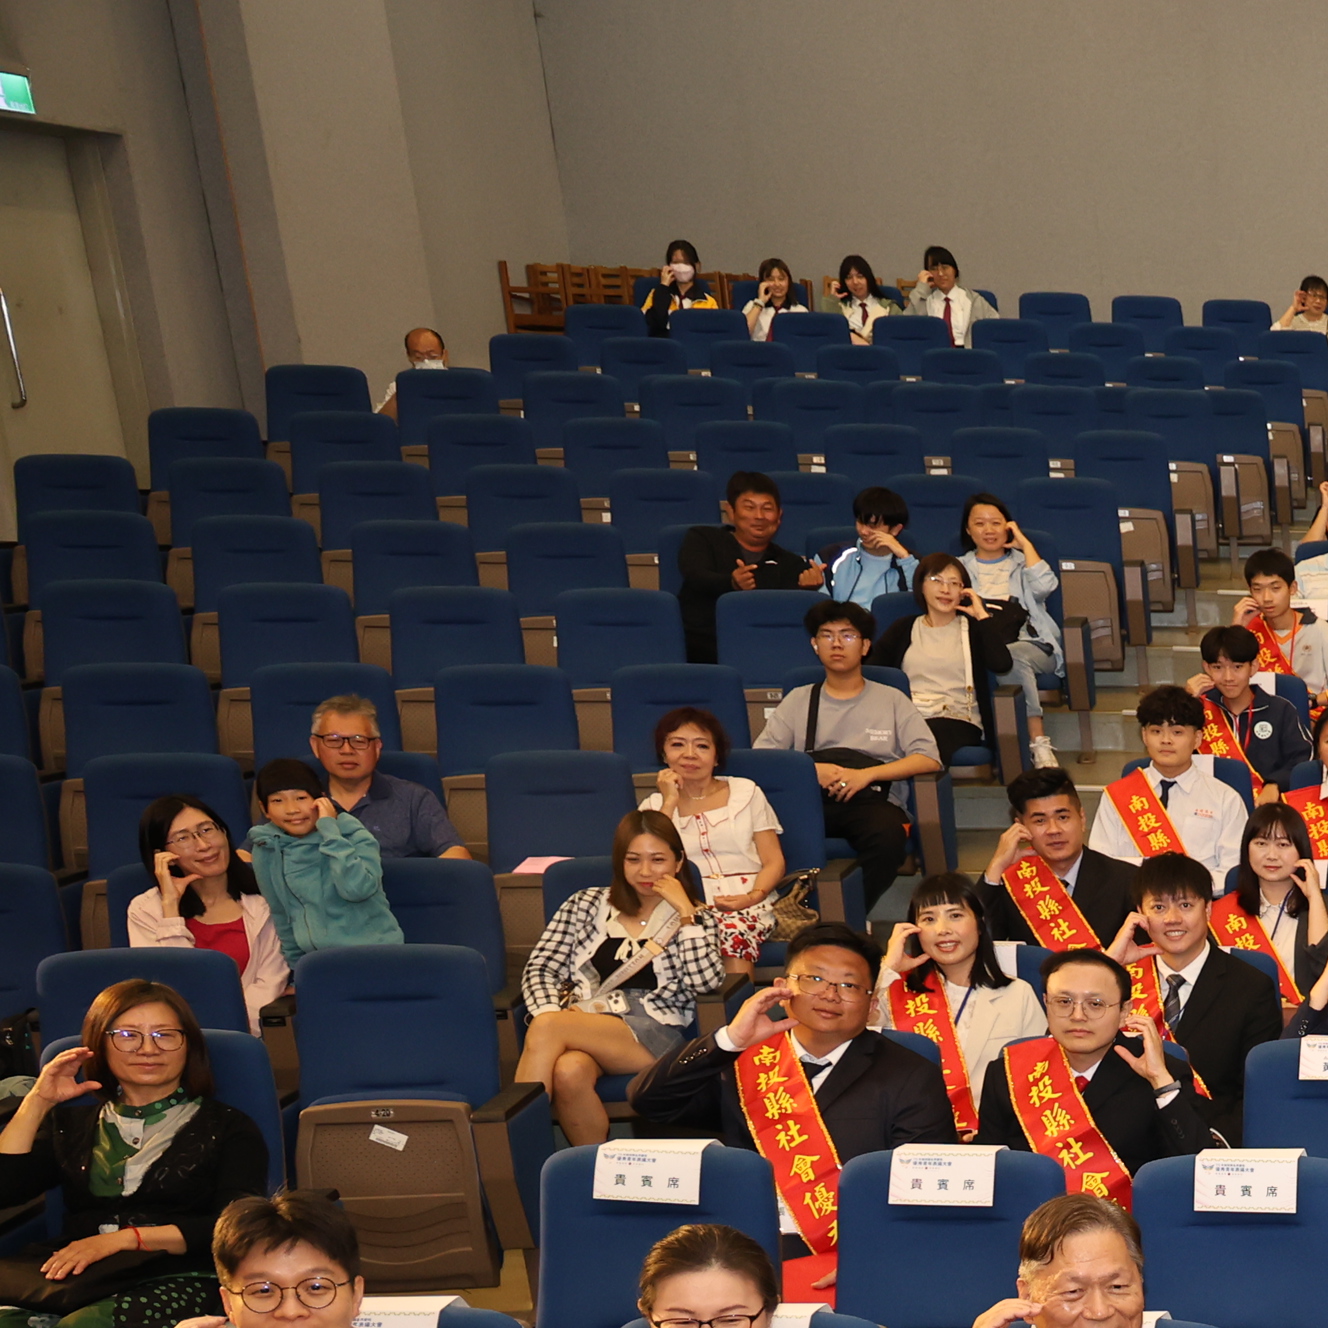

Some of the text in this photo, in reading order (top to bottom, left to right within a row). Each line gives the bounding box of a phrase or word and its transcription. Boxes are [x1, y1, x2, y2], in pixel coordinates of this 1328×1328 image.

[1128, 795, 1172, 853] 南投縣
[613, 1173, 680, 1190] 貴賓席
[911, 1178, 975, 1192] 貴賓席
[1214, 1184, 1278, 1199] 貴賓席
